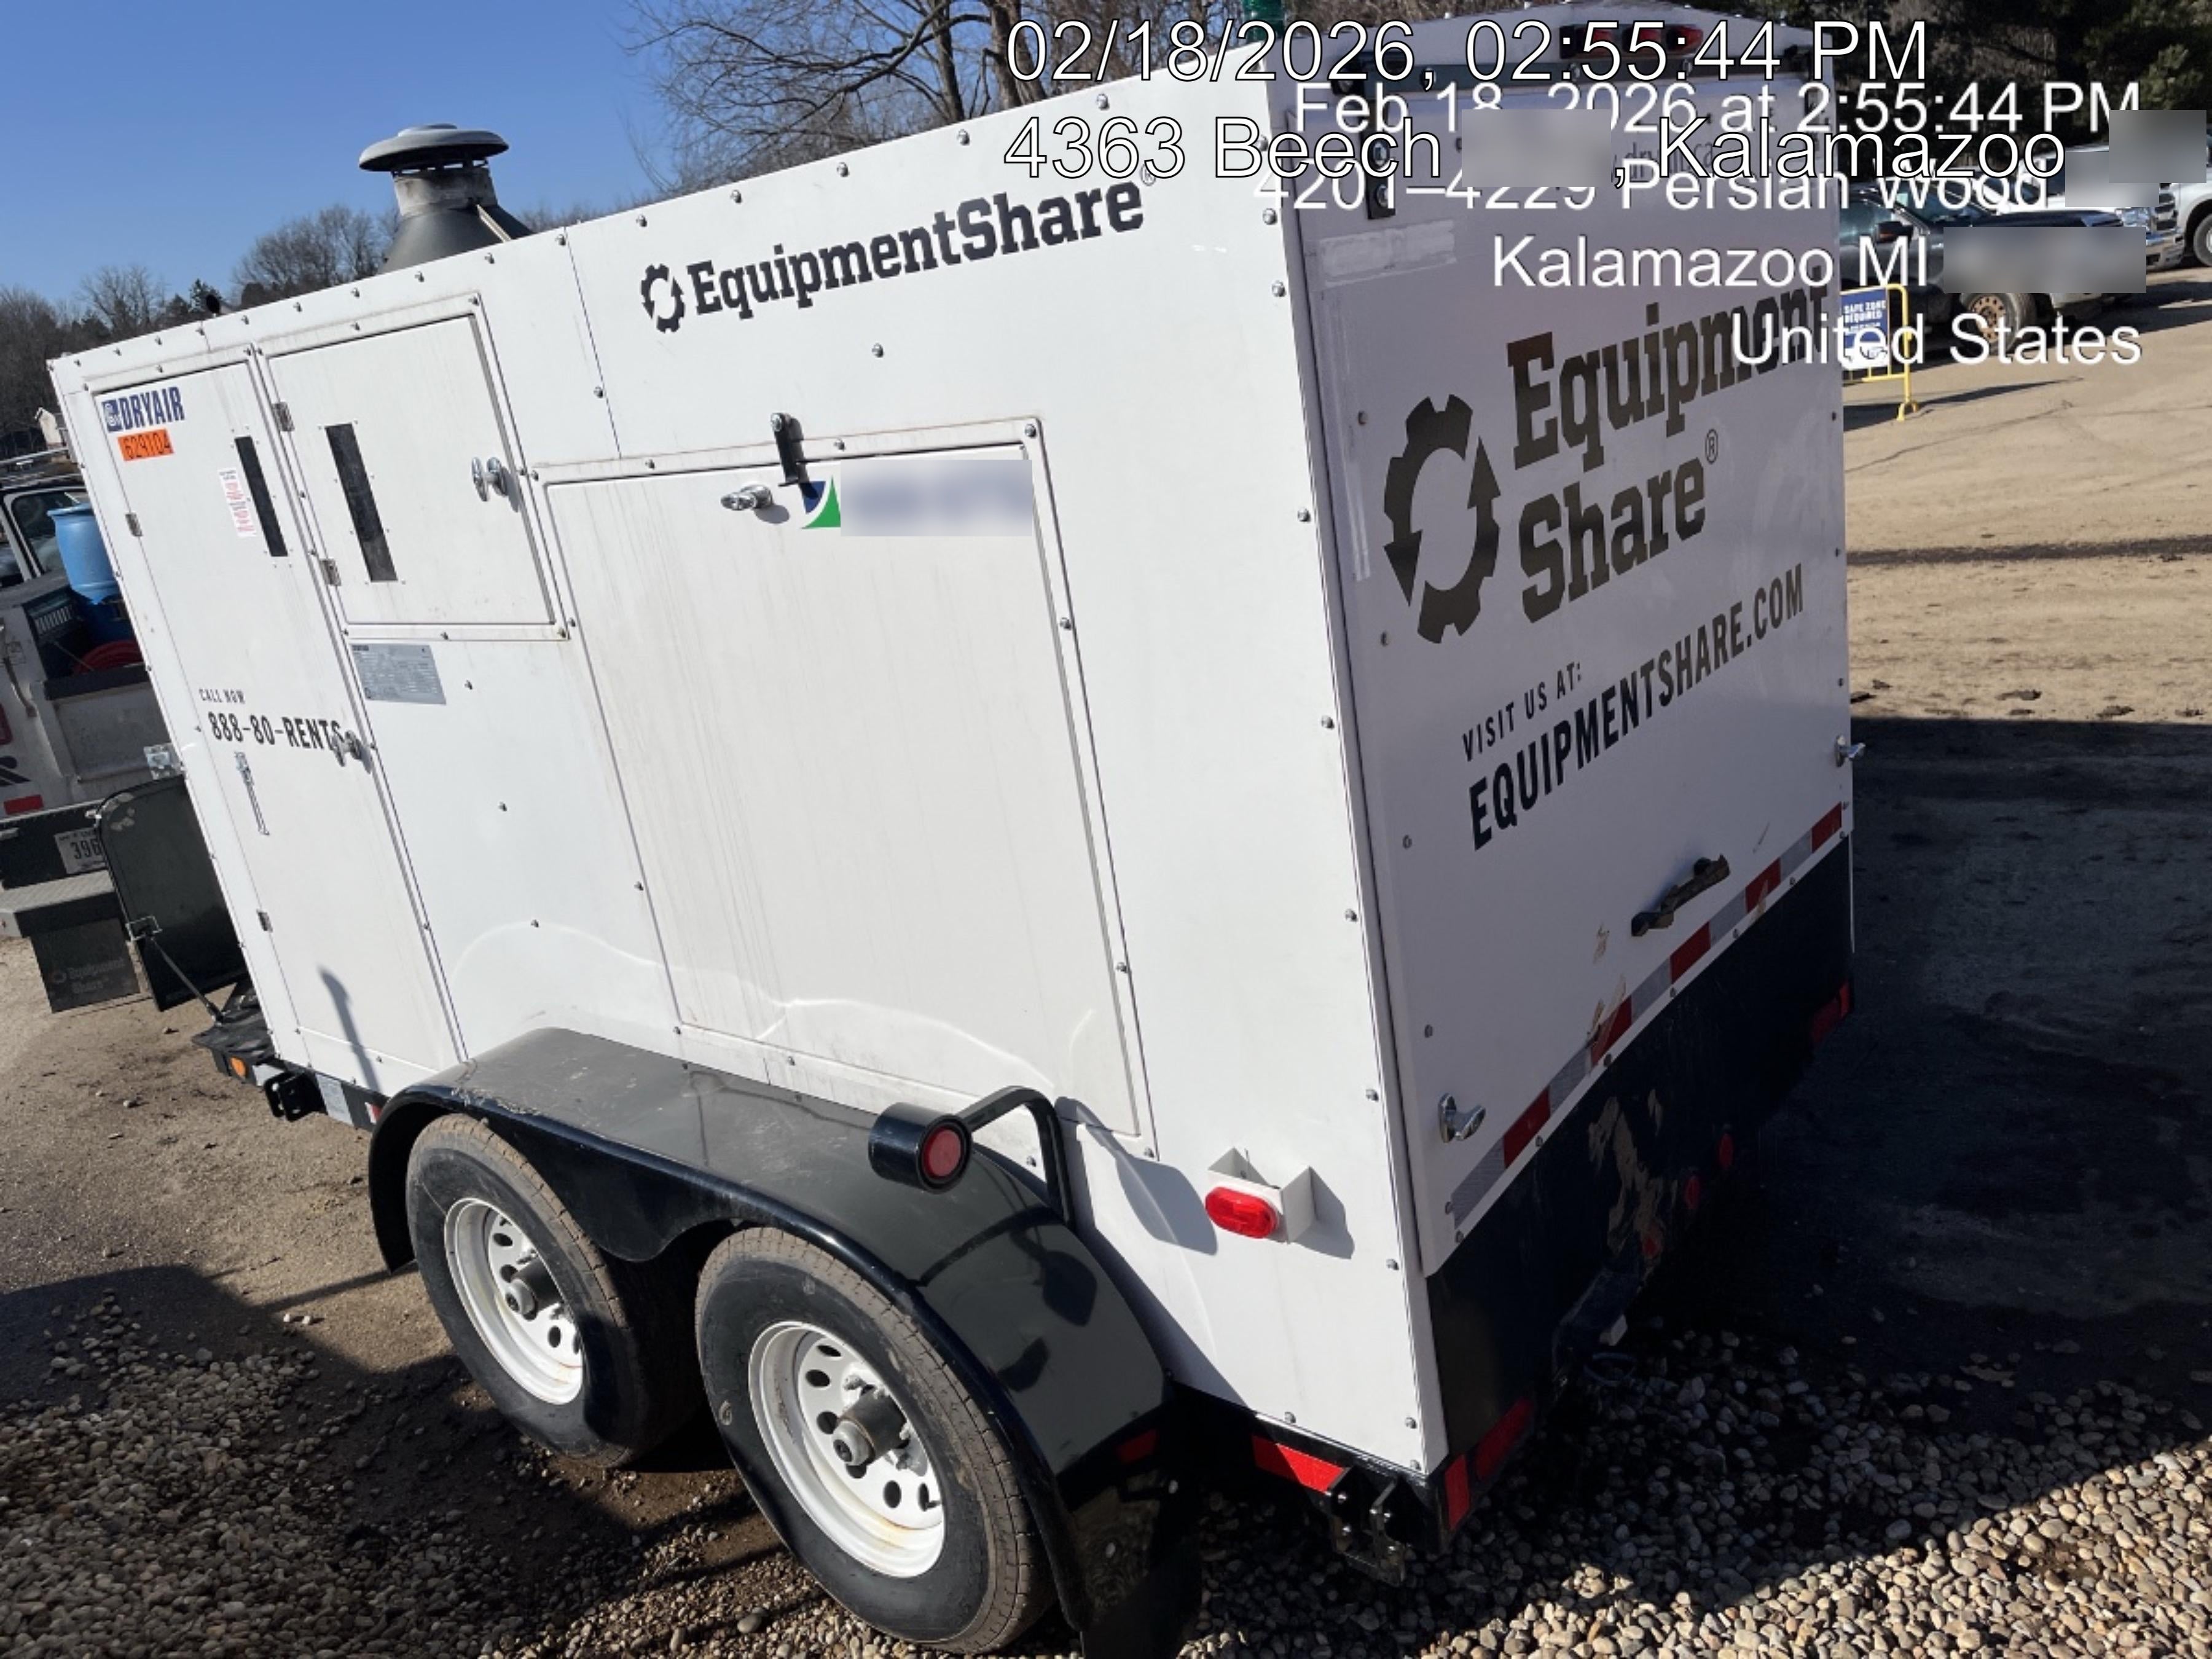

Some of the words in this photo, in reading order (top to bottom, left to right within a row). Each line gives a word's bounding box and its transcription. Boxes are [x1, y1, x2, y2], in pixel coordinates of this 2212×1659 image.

[685, 179, 1144, 321] EquipmentShare
[118, 386, 185, 429] DRYAIR
[1506, 265, 1829, 473] Equipment
[123, 431, 174, 460] 629104
[1518, 457, 1706, 624] Share
[198, 688, 222, 703] CALL
[223, 689, 246, 704] NOW
[1462, 702, 1515, 763] VISIT
[1524, 681, 1548, 720] US
[1556, 661, 1582, 700] AT:
[1469, 563, 1803, 852] EQUIPMENTSHARE.COM
